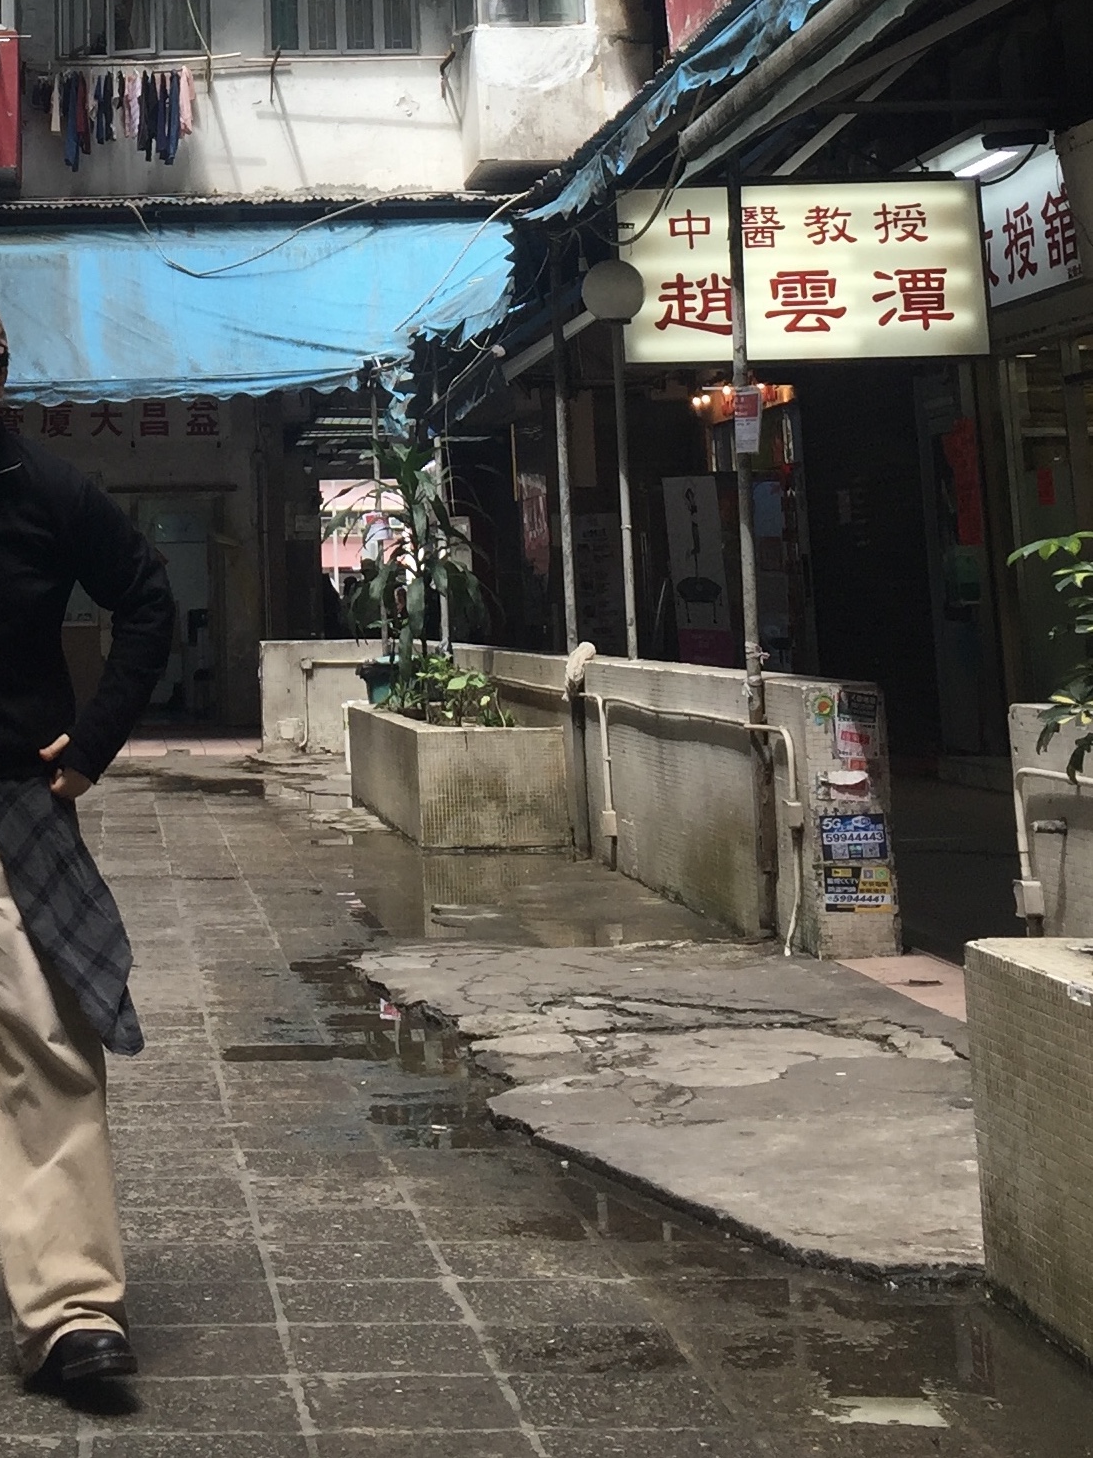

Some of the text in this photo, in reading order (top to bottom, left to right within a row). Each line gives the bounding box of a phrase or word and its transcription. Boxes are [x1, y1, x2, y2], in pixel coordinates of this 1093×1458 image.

[668, 203, 928, 250] 中醫教授
[654, 267, 955, 336] 趙雲潭
[825, 832, 884, 843] 59944443
